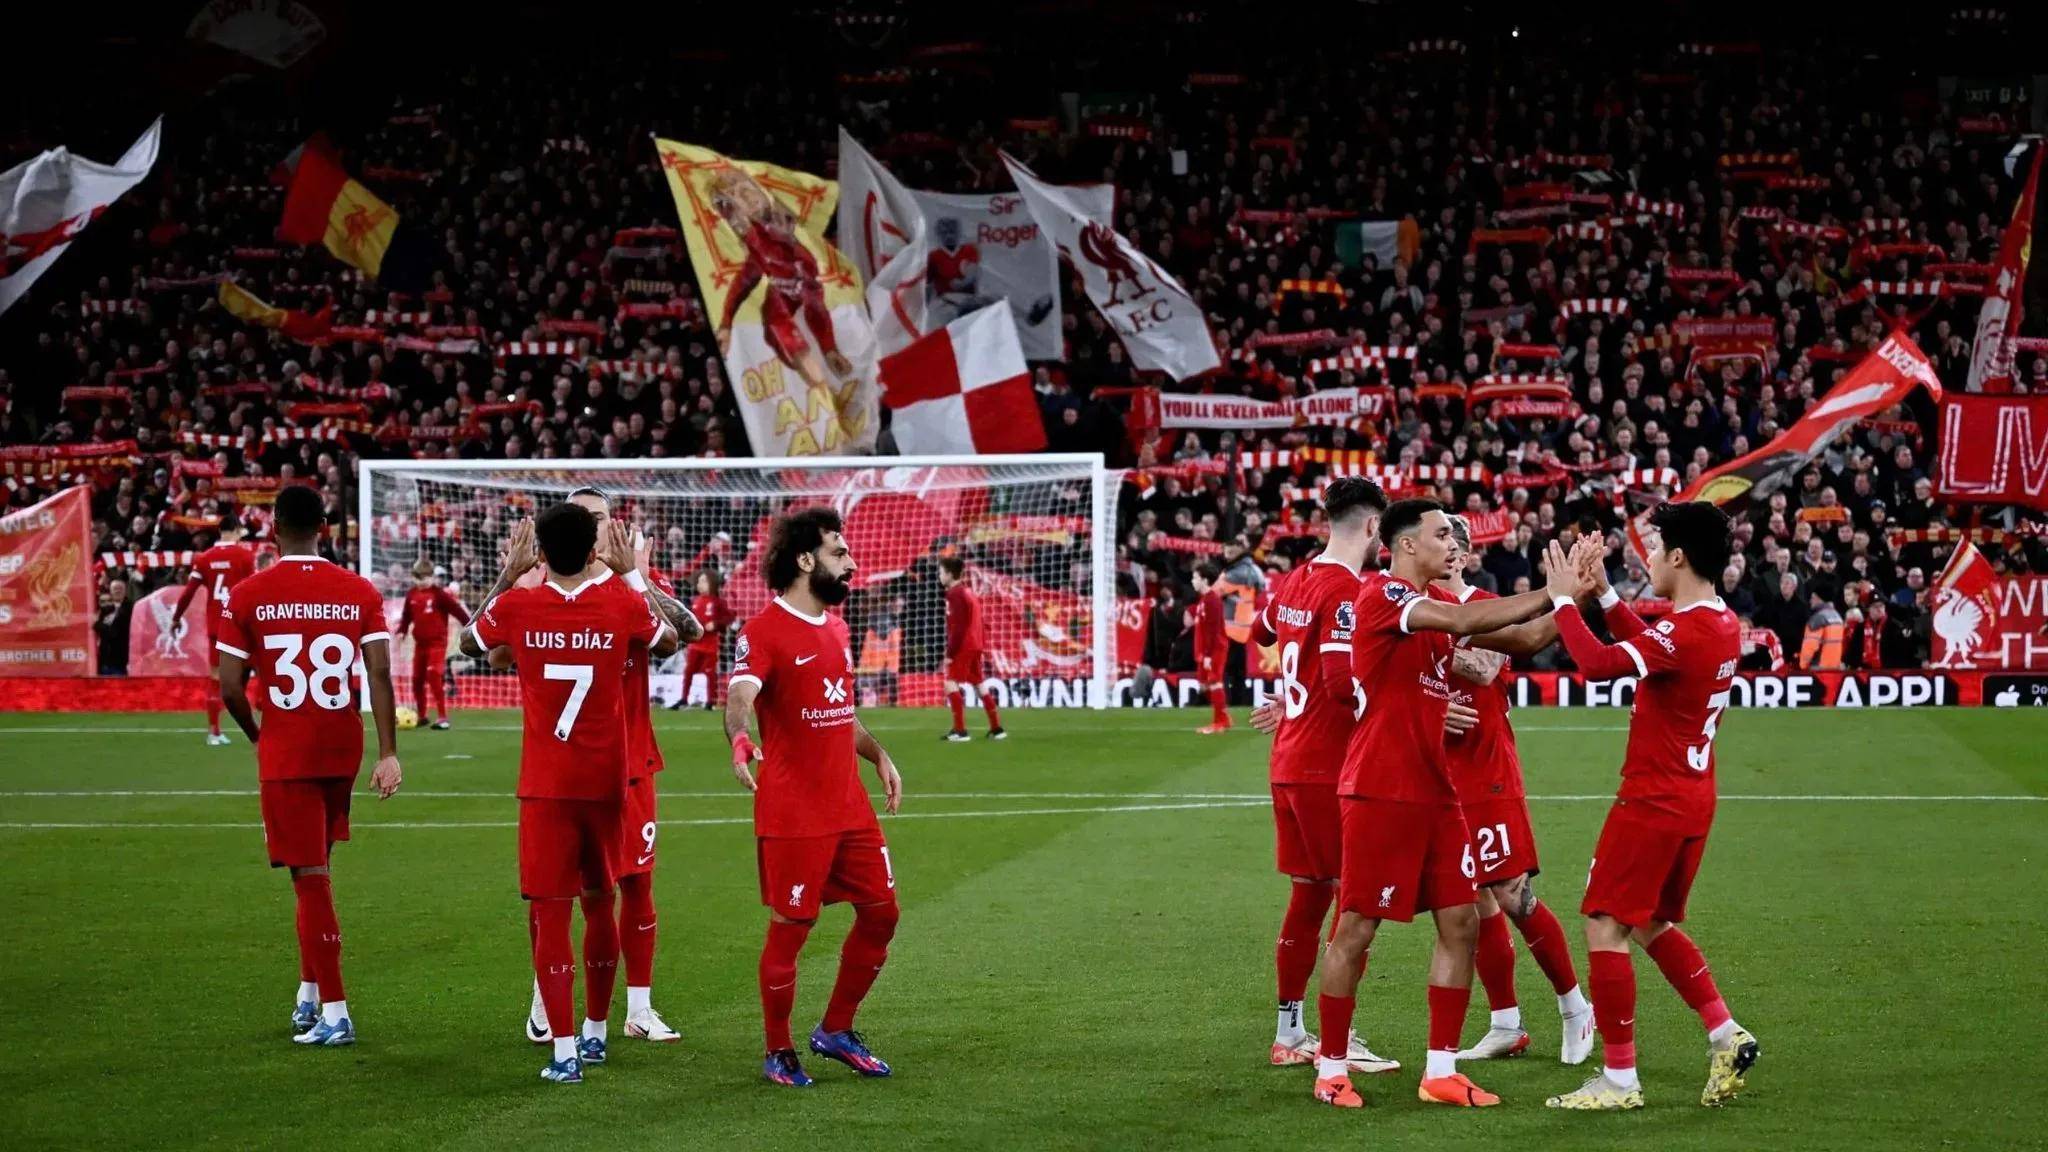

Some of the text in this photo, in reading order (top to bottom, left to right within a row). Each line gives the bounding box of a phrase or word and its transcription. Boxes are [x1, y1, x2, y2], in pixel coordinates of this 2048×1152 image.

[989, 196, 1021, 215] Sir
[978, 222, 1039, 247] Roger
[742, 357, 784, 402] OH
[1213, 402, 1259, 420] NEVER
[1308, 397, 1353, 415] ALONE
[256, 604, 360, 621] GRAVENBERCH
[525, 627, 614, 649] LUIS DÍAZ
[263, 633, 355, 710] 38
[1282, 641, 1308, 719] 8
[543, 663, 594, 742] 7
[1836, 675, 1945, 707] APP!
[641, 821, 656, 853] 9
[1477, 823, 1511, 862] 21
[1460, 843, 1477, 879] 6
